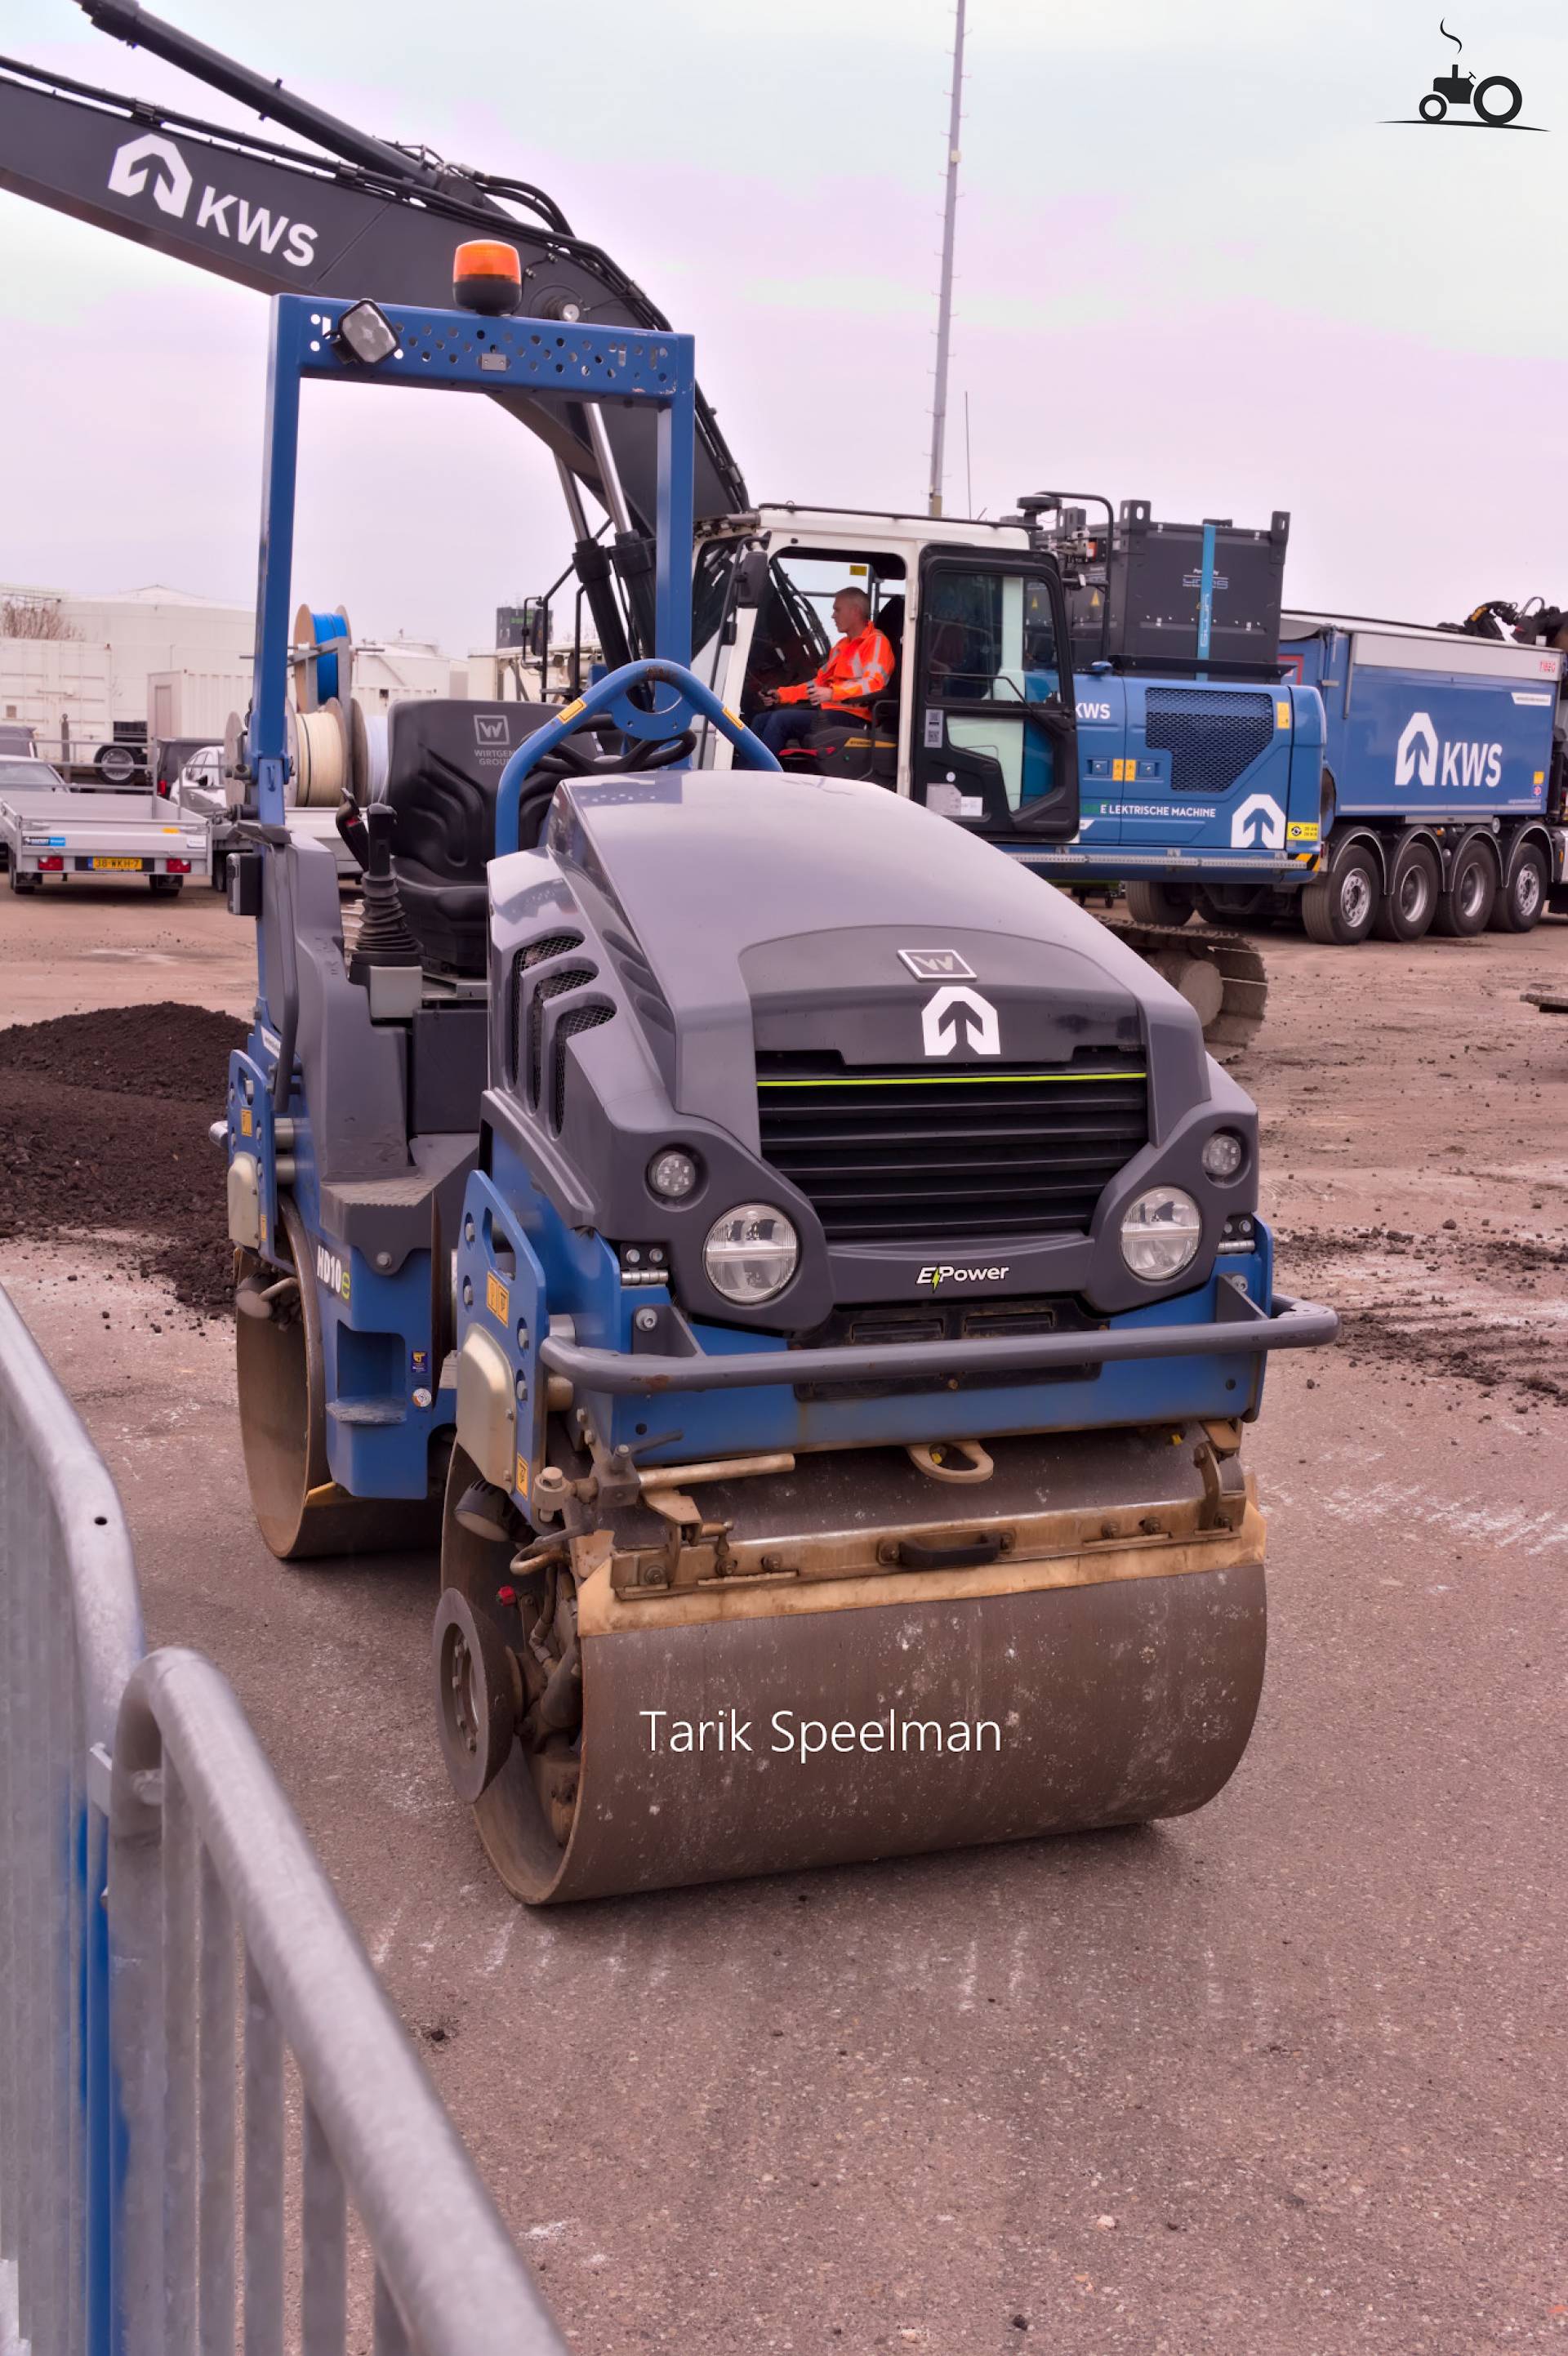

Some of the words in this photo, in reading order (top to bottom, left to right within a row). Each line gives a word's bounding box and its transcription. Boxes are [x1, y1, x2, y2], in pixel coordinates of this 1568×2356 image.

[197, 185, 318, 267] KWS
[1441, 742, 1503, 787] KWS
[1171, 807, 1216, 817] MACHINE
